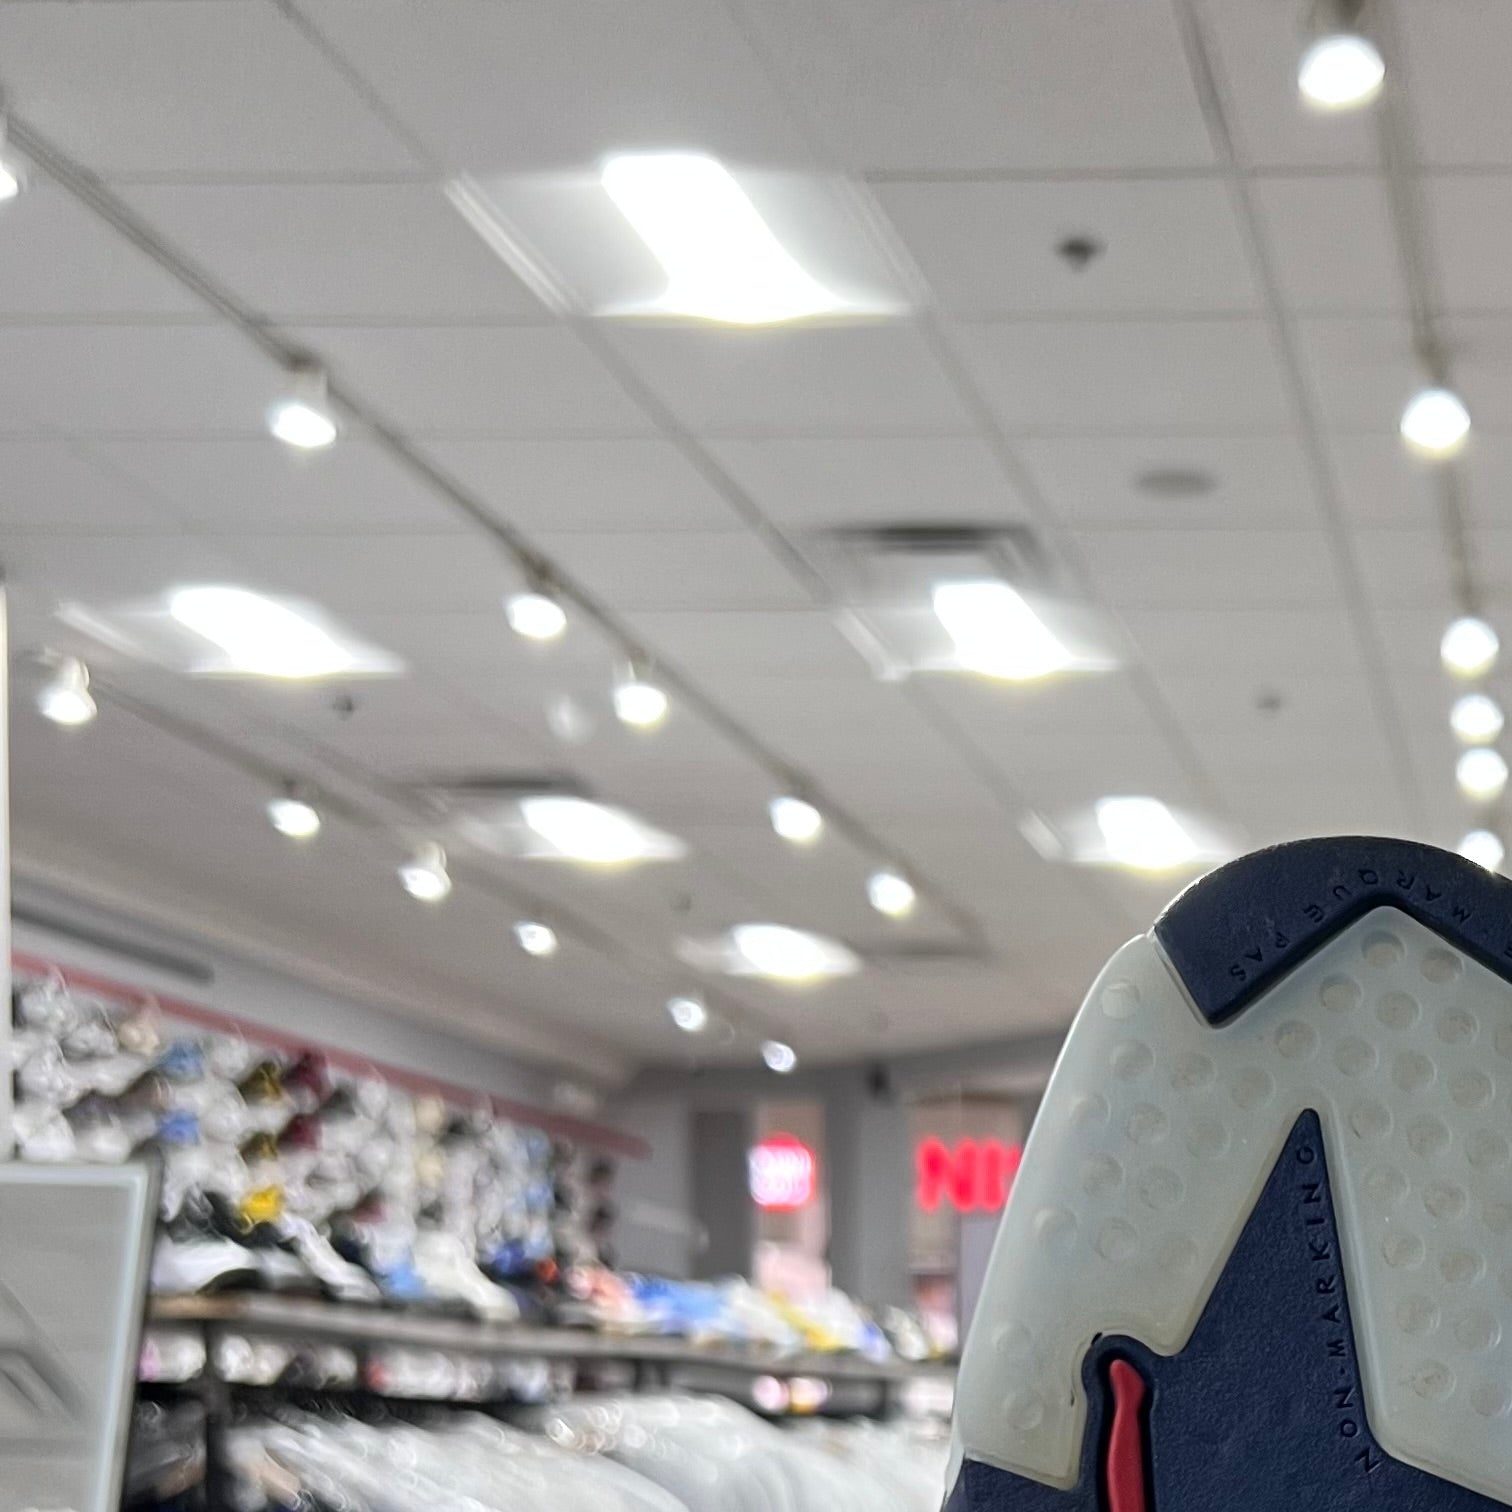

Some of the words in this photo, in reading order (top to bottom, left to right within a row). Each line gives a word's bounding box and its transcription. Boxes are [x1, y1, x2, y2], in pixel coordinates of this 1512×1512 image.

[1303, 867, 1475, 925] MARQUE
[1228, 930, 1291, 983] PAS
[1295, 1144, 1380, 1475] NON-MARKING
